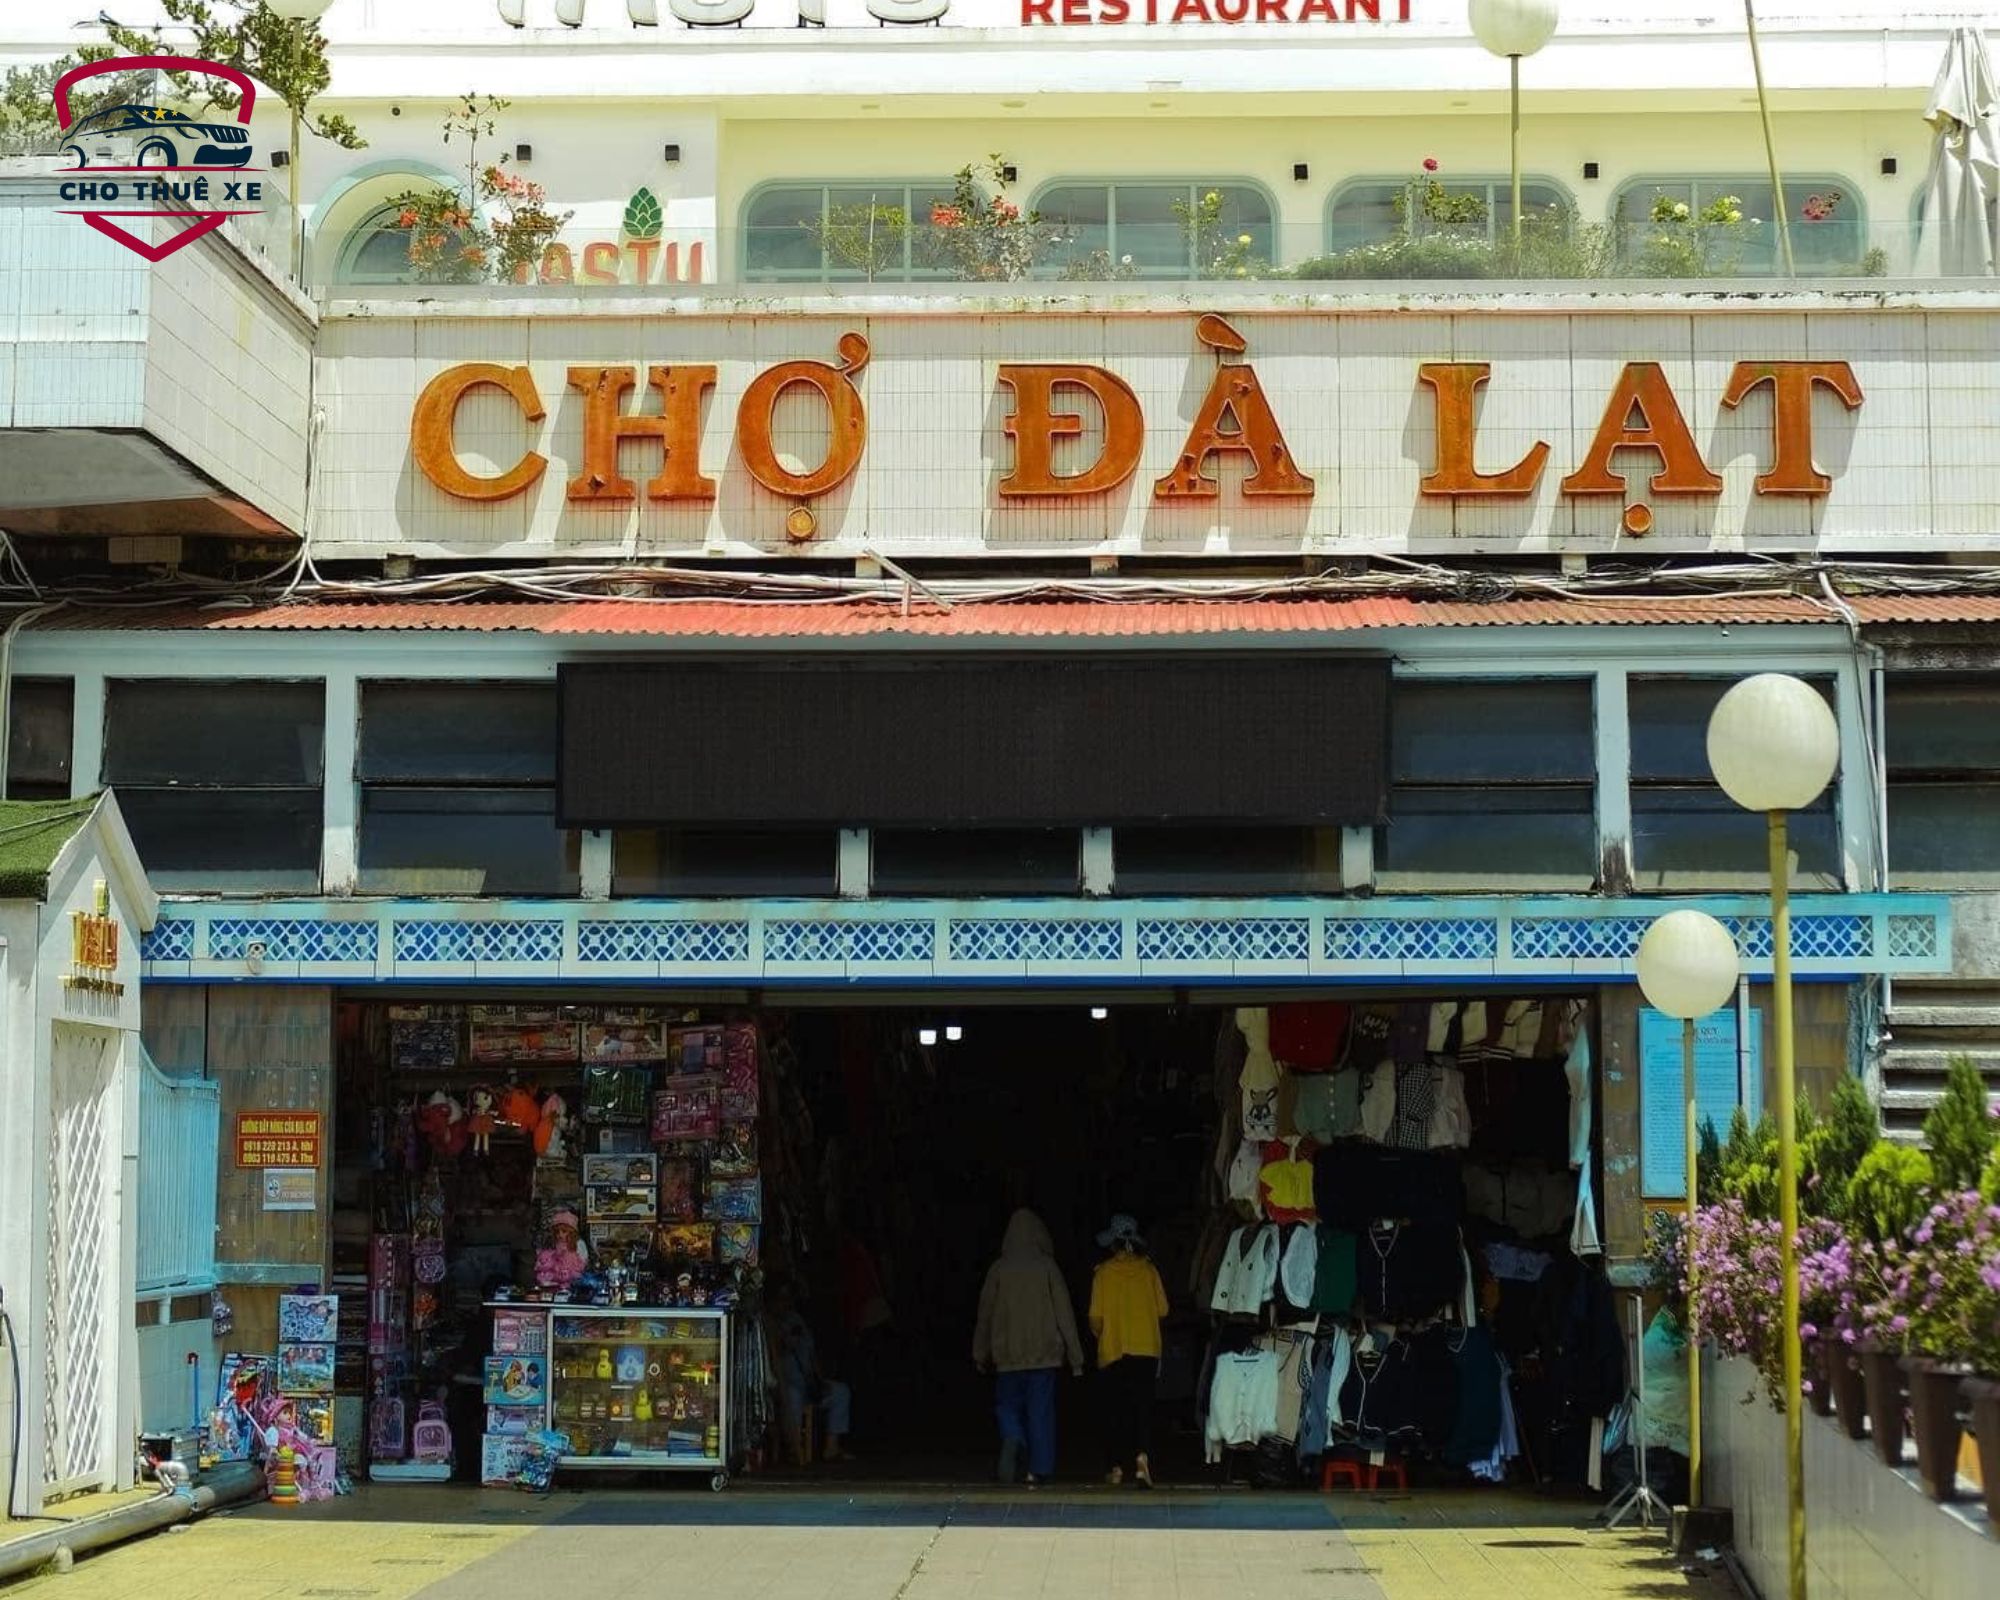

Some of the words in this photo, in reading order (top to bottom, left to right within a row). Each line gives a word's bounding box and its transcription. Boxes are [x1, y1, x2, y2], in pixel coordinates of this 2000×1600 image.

[411, 331, 872, 541] CHỢ
[998, 313, 1315, 499] ĐÀ
[1419, 360, 1865, 537] LẠT
